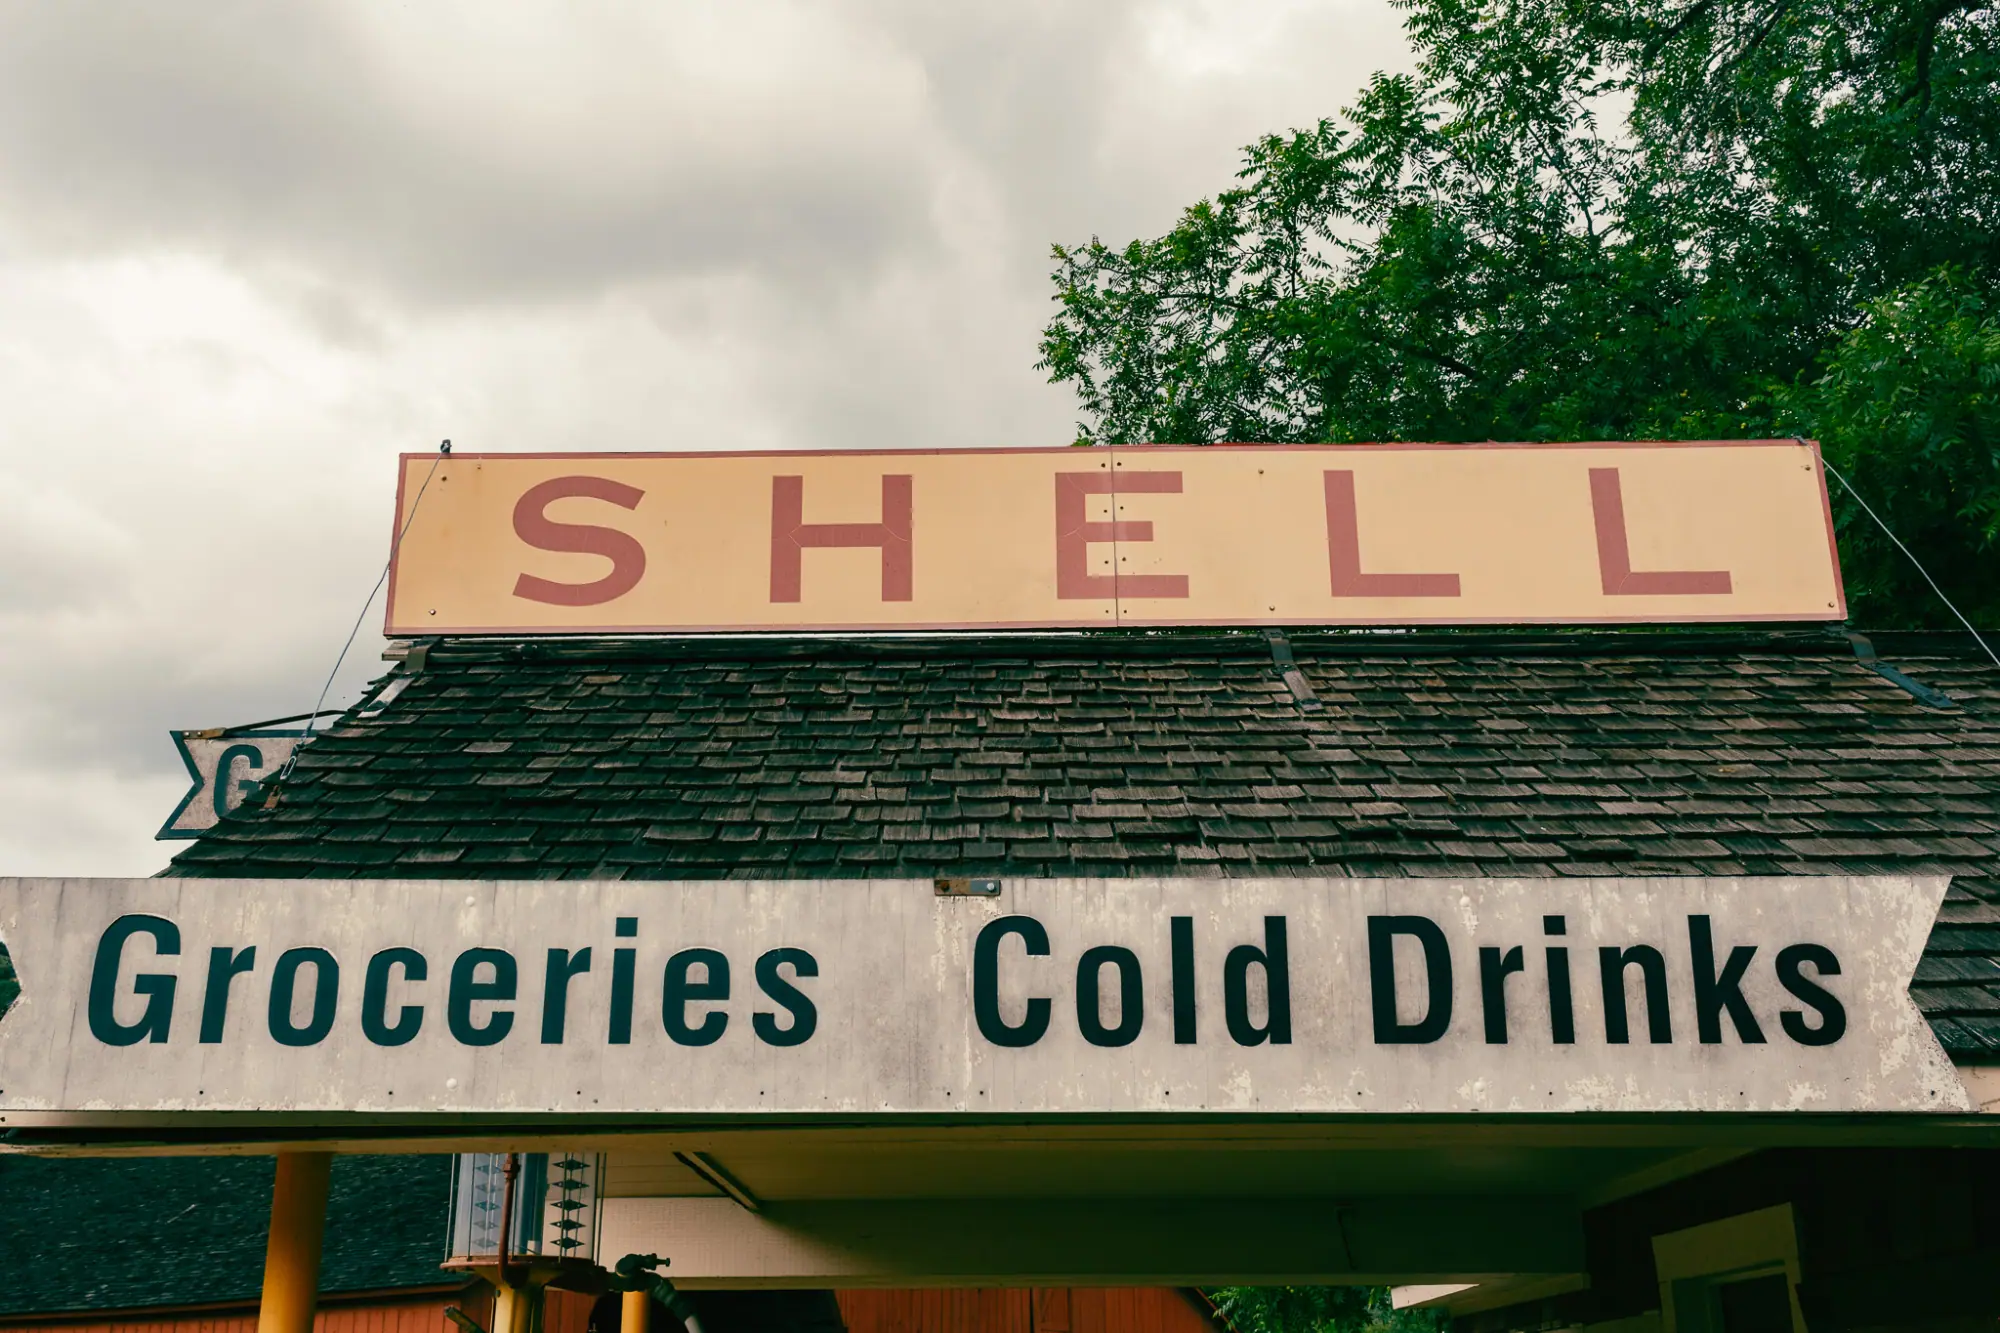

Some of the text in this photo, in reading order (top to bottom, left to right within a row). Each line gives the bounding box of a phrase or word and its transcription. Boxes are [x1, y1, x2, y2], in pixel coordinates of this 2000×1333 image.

[513, 467, 1731, 606] SHELL
[88, 913, 1847, 1047] Groceries Cold Drinks
